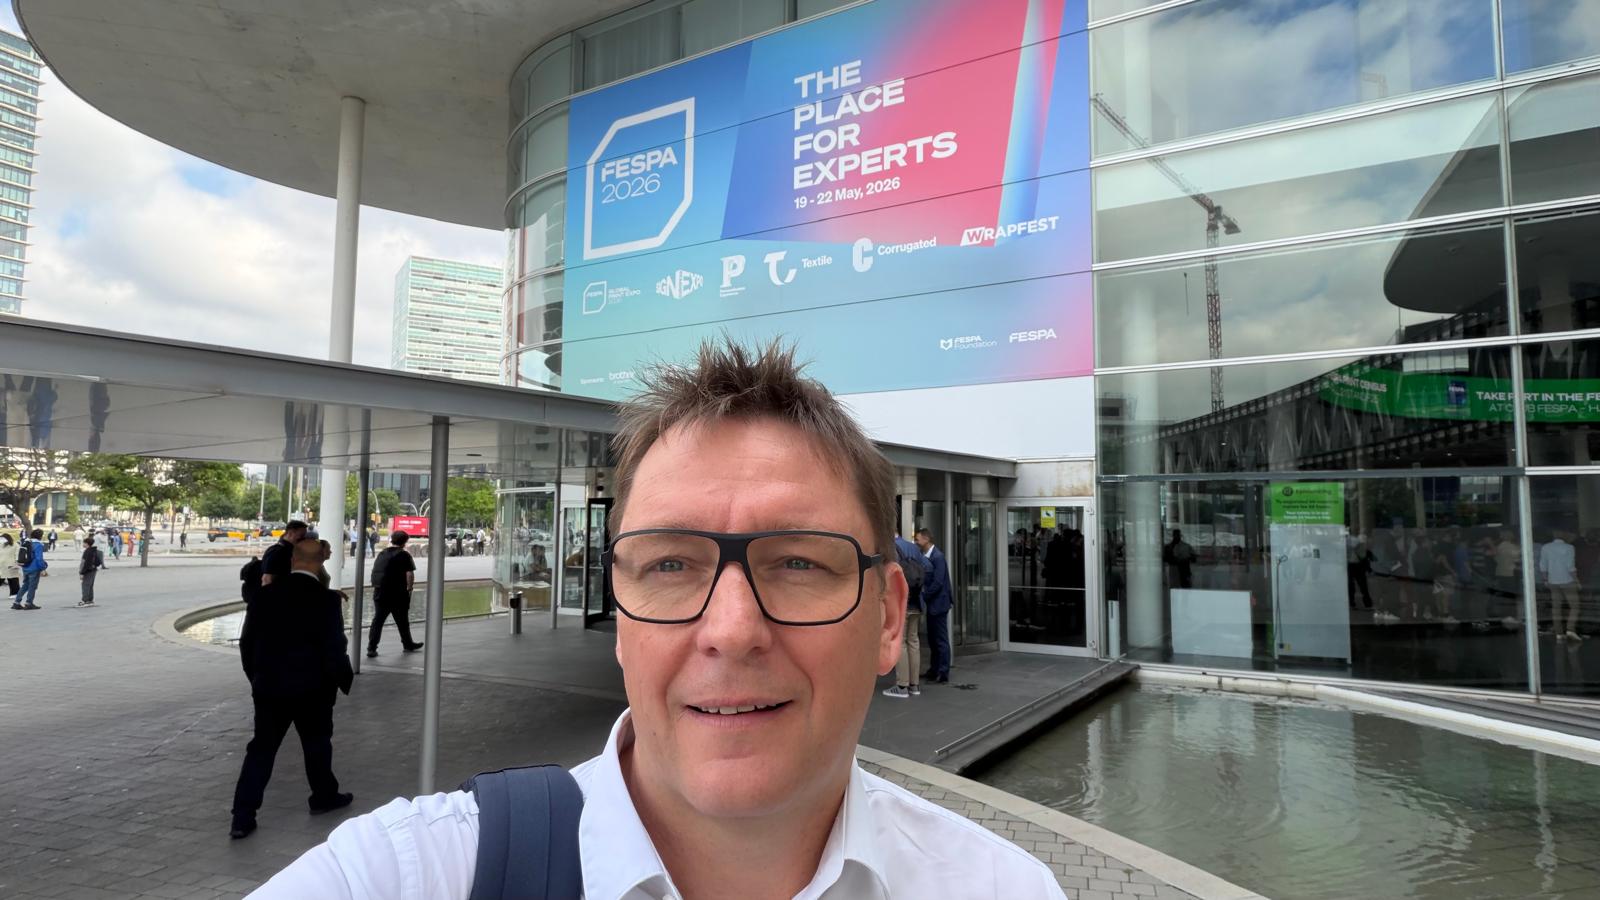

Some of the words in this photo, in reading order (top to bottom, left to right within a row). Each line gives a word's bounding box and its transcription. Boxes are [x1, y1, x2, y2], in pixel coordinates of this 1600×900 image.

[794, 60, 862, 98] THE
[794, 78, 905, 130] PLACE
[794, 123, 861, 160] FOR
[601, 146, 678, 182] FESPA
[794, 131, 958, 190] EXPERTS
[602, 173, 661, 204] 2026
[794, 196, 808, 209] 19
[817, 191, 833, 205] 22
[835, 187, 864, 201] May,
[866, 176, 901, 195] 2026
[877, 236, 937, 256] Corrugated
[960, 216, 1060, 247] WRAPFEST
[801, 255, 833, 269] Textile
[1009, 328, 1057, 344] FESPA
[1476, 391, 1506, 401] TAKE
[1508, 391, 1539, 402] PRT
[1541, 393, 1554, 402] IN
[1556, 393, 1583, 402] THE
